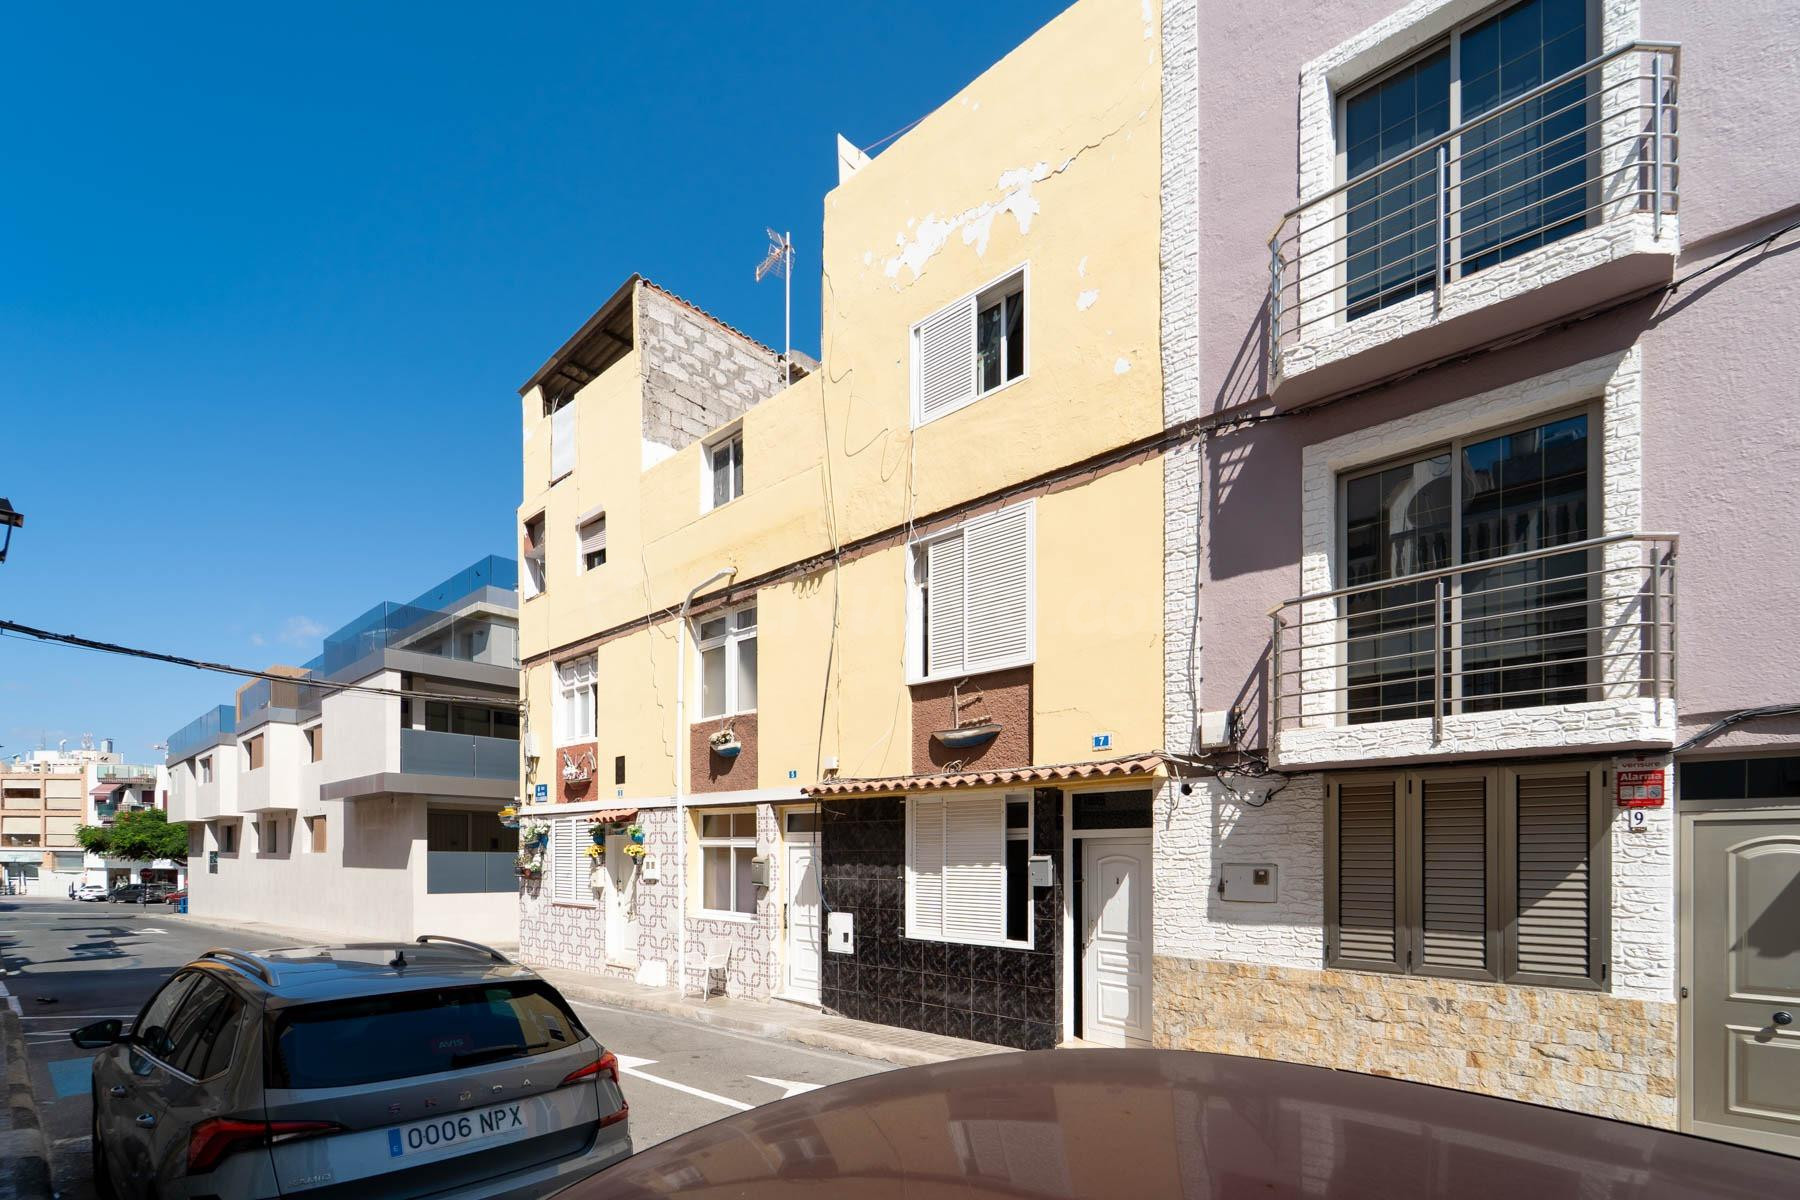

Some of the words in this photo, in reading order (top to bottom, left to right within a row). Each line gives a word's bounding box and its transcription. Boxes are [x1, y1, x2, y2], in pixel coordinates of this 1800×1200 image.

[1620, 772, 1663, 781] Alarma
[1634, 811, 1644, 826] 9
[439, 1039, 464, 1048] AVIS
[408, 1117, 472, 1149] 0006
[479, 1105, 523, 1134] NPX
